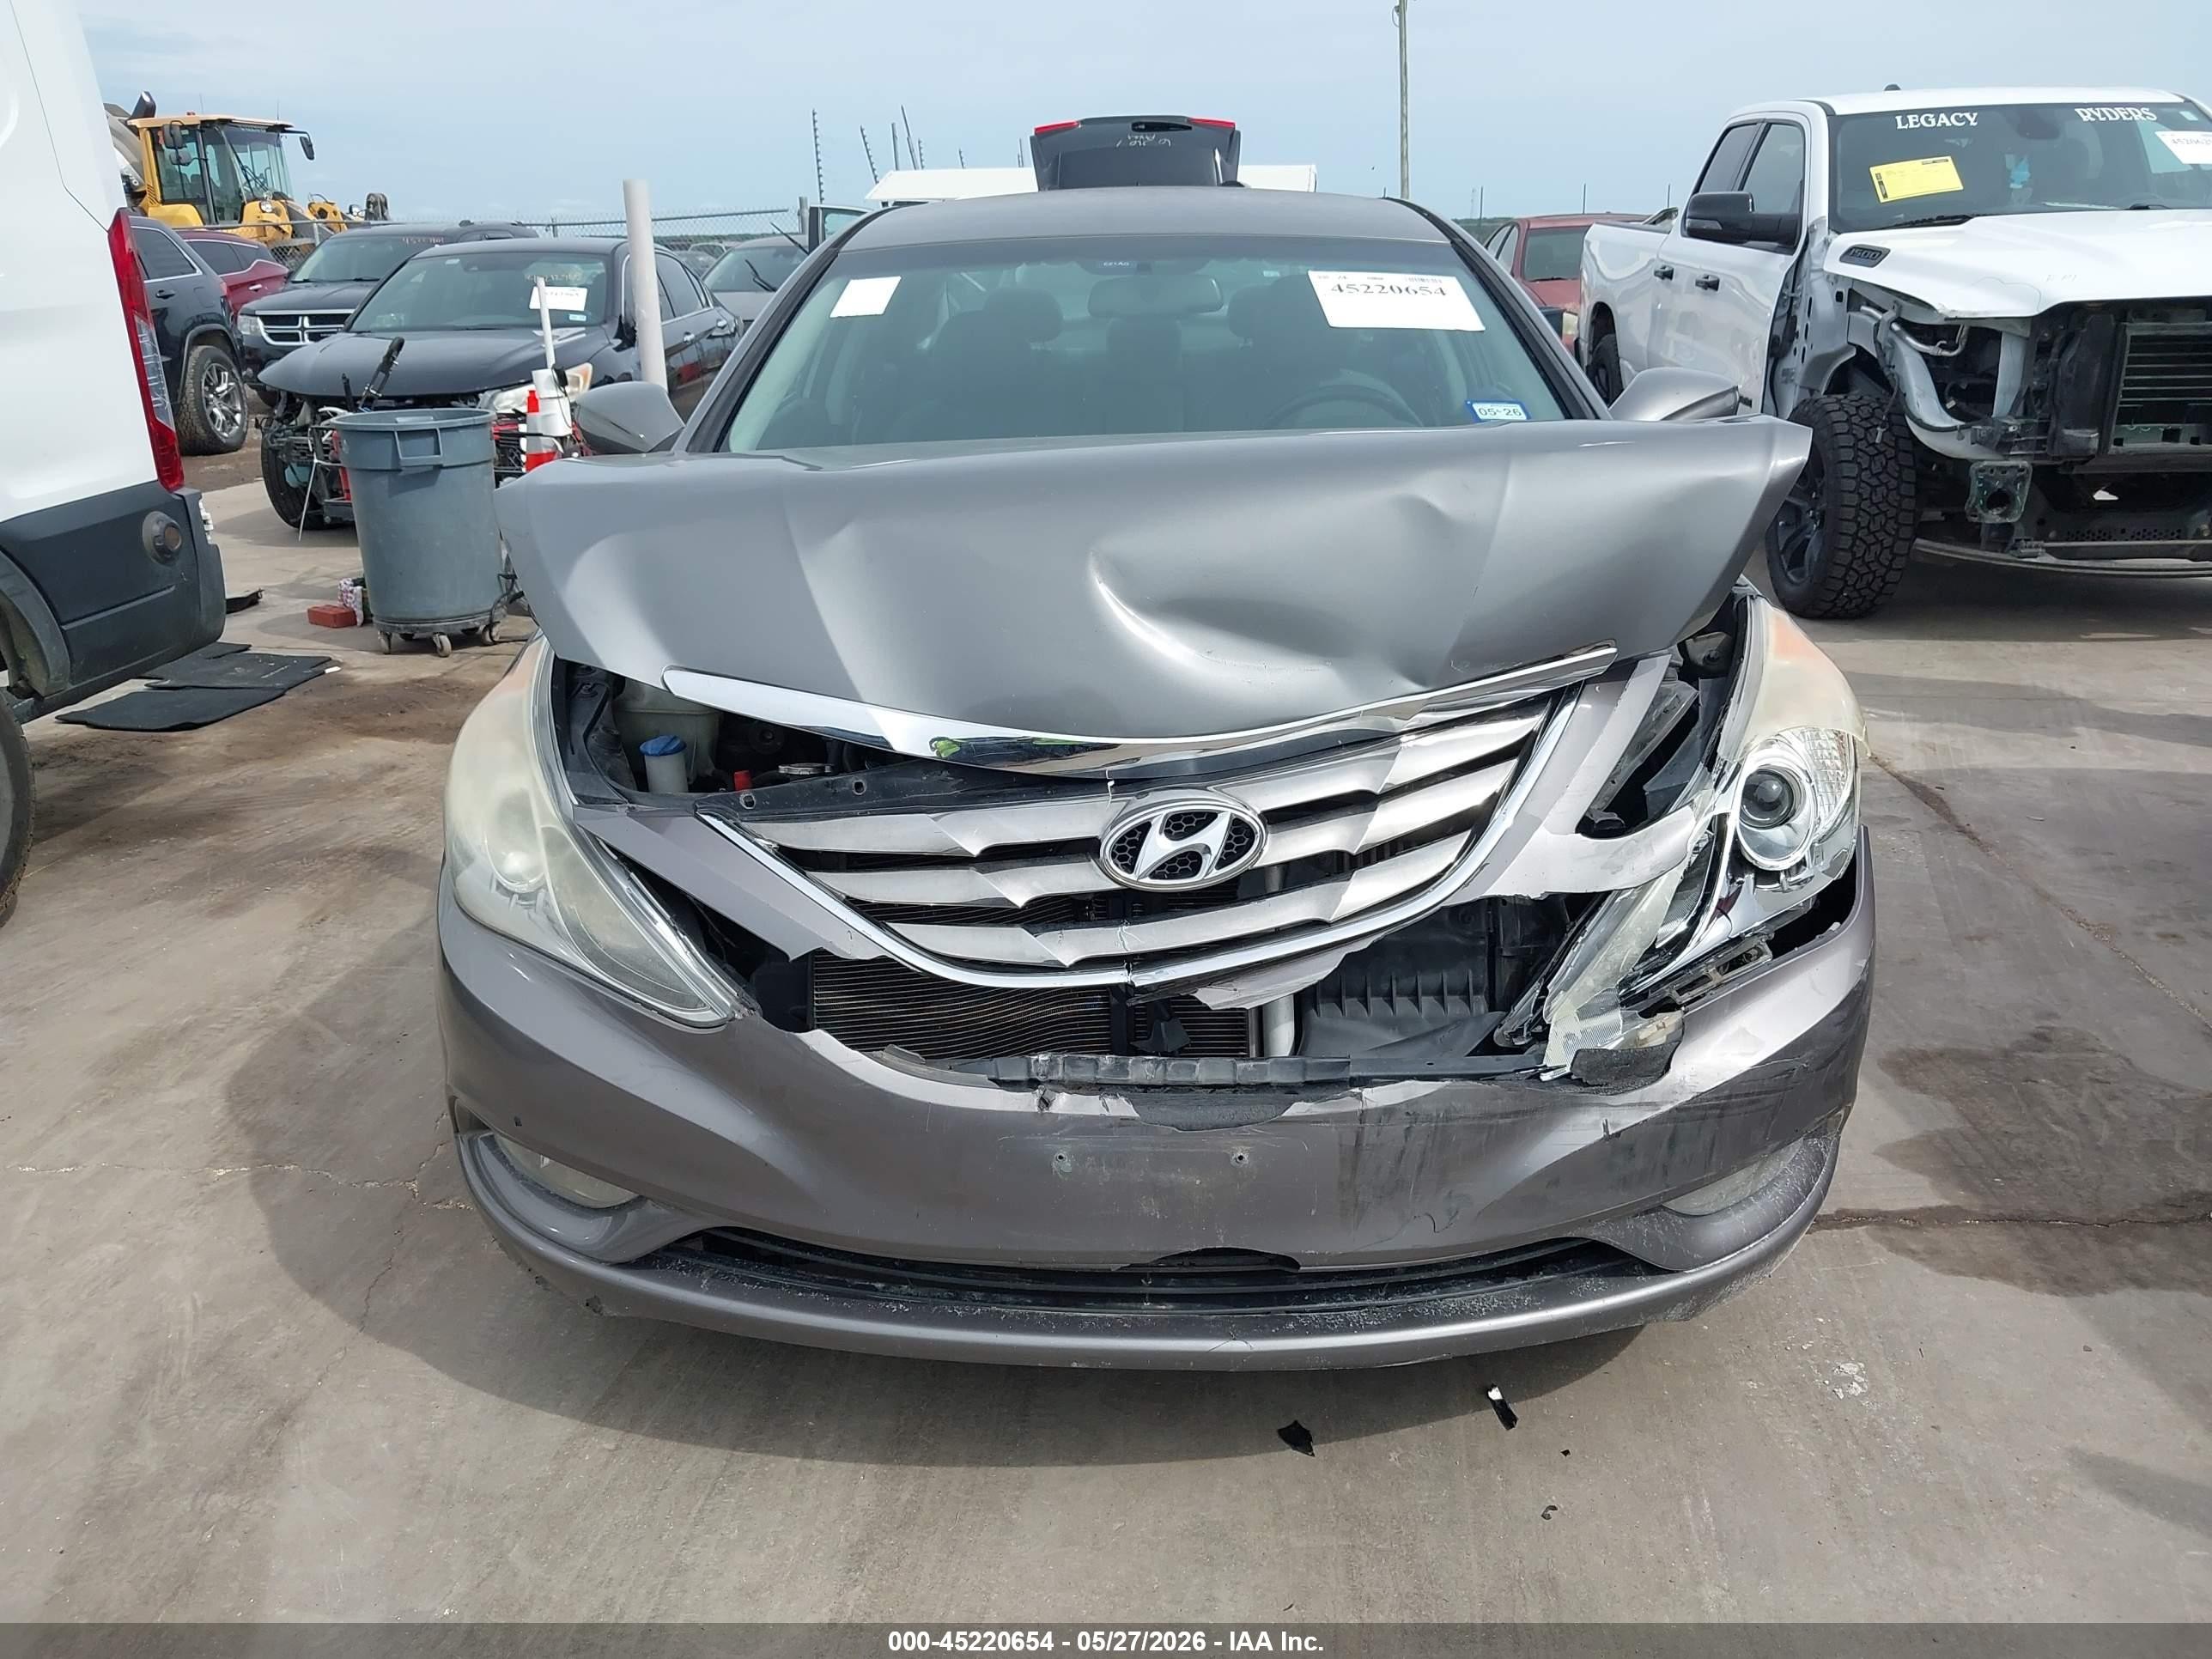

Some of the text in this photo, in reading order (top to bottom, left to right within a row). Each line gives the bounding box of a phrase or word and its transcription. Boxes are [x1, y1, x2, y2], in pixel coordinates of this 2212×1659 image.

[1895, 107, 2158, 130] LEGACY RYDERS
[1849, 247, 1881, 259] 1500
[1331, 283, 1446, 296] 45220654
